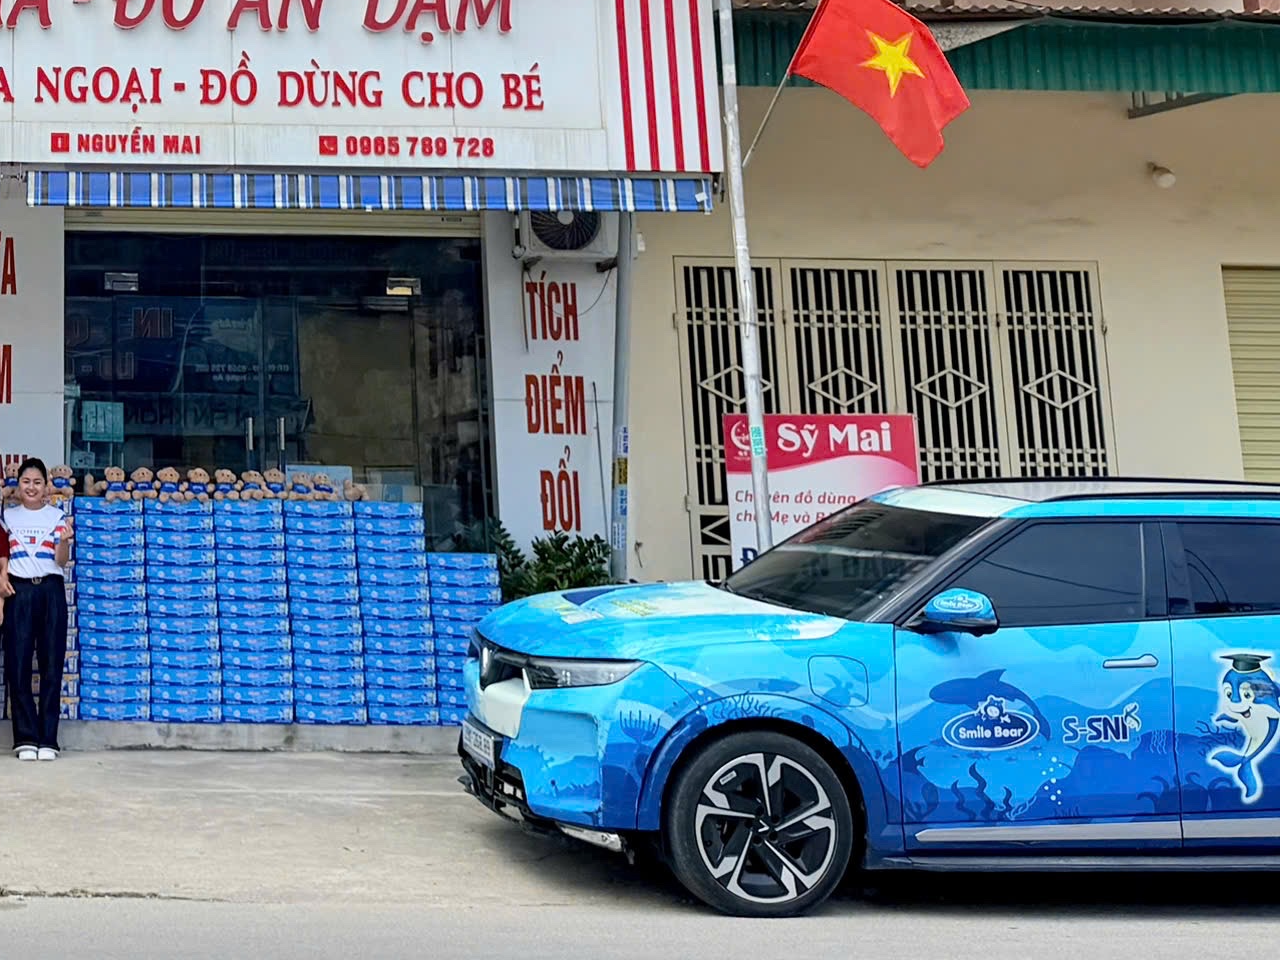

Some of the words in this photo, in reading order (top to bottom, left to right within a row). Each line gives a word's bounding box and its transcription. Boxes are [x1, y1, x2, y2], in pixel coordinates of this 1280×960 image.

[35, 65, 162, 113] NGOẠI
[200, 51, 258, 106] ĐỒ
[277, 59, 383, 109] DÙNG
[401, 70, 483, 109] CHO
[502, 62, 544, 111] BÉ
[163, 134, 201, 155] MAI
[453, 137, 495, 158] 728
[525, 271, 579, 342] TÍCH
[525, 350, 587, 435] ĐIỂM
[777, 423, 819, 458] Sỹ
[829, 421, 892, 452] Mai
[540, 445, 581, 532] ĐỔI
[735, 490, 789, 503] Chên
[793, 512, 810, 523] và
[959, 725, 991, 739] Smile
[995, 726, 1023, 738] Bear
